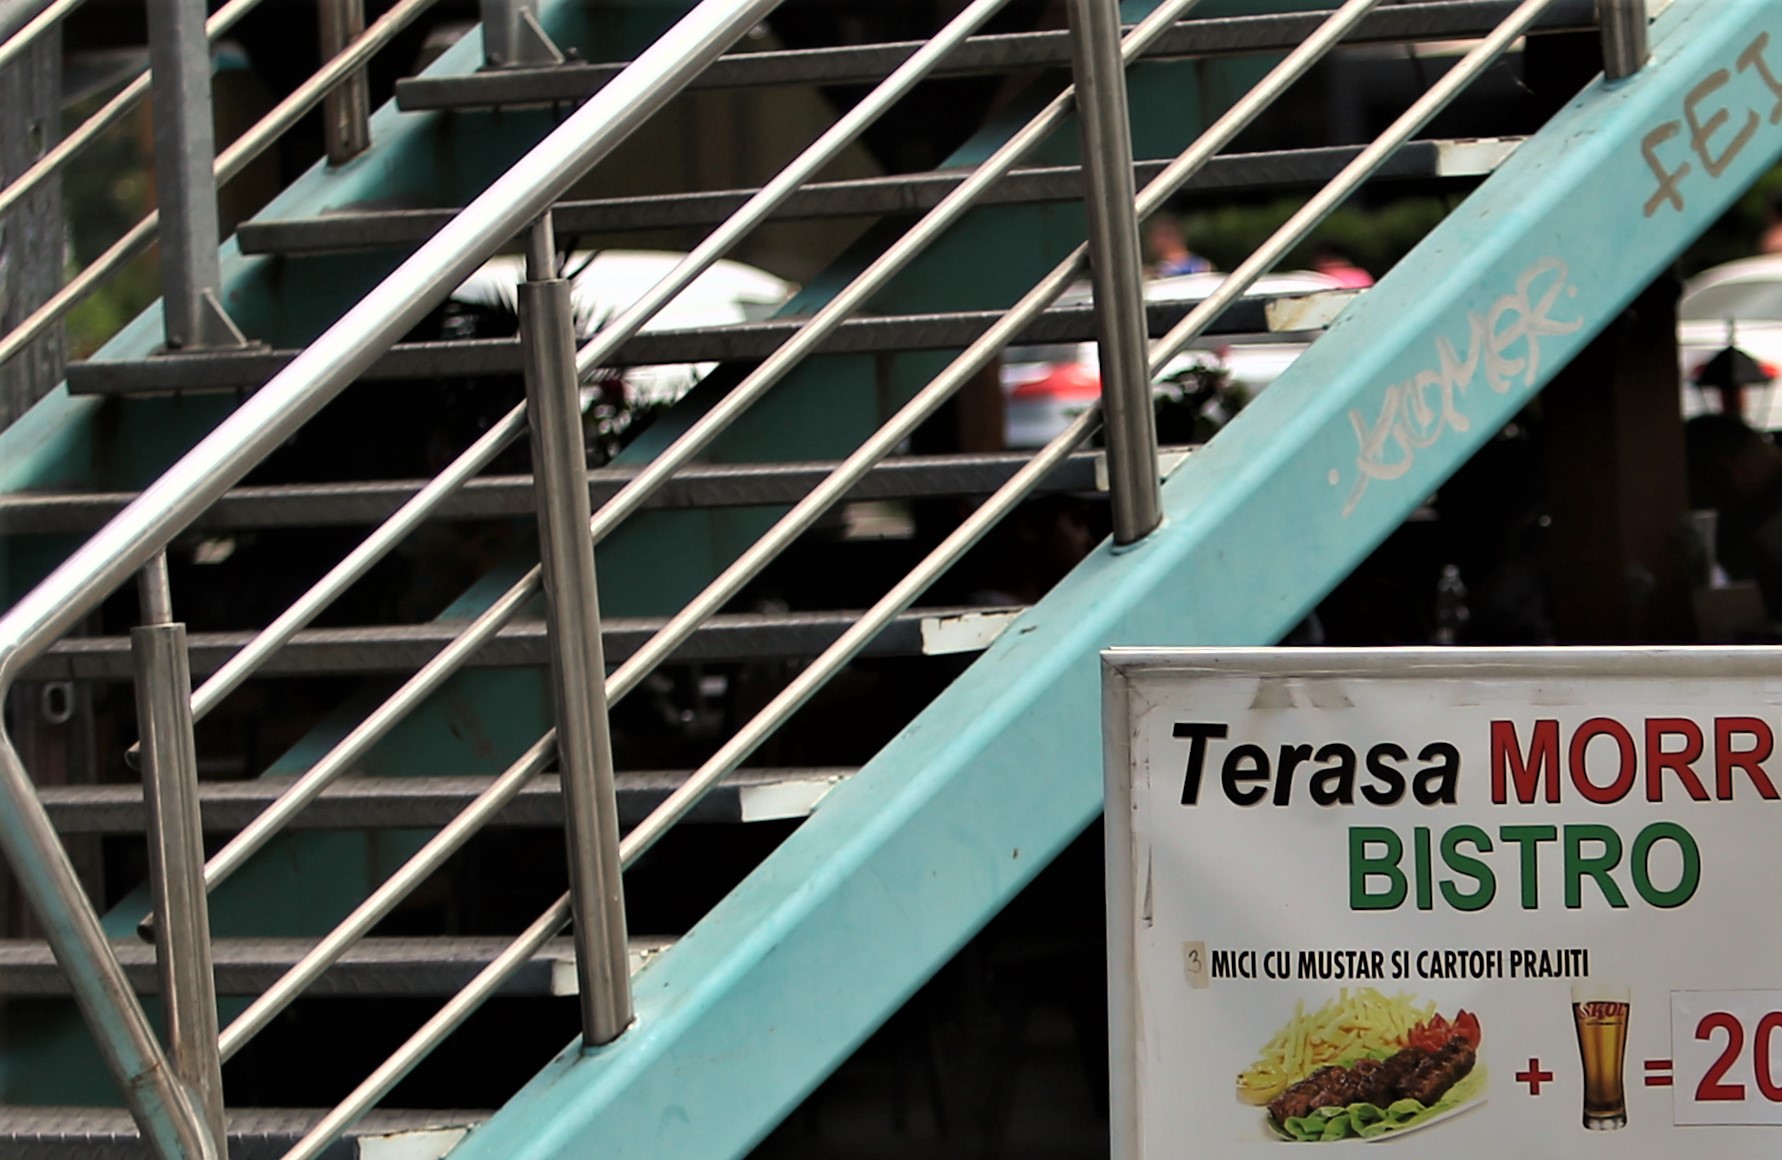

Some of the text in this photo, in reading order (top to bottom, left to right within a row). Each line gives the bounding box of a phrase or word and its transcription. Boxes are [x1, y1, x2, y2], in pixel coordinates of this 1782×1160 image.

[1173, 723, 1459, 806] Terasa
[1349, 822, 1700, 911] BISTRO
[1188, 949, 1588, 979] 3 MICI CU MUSTAR SI CARTOFI PRAJITI
